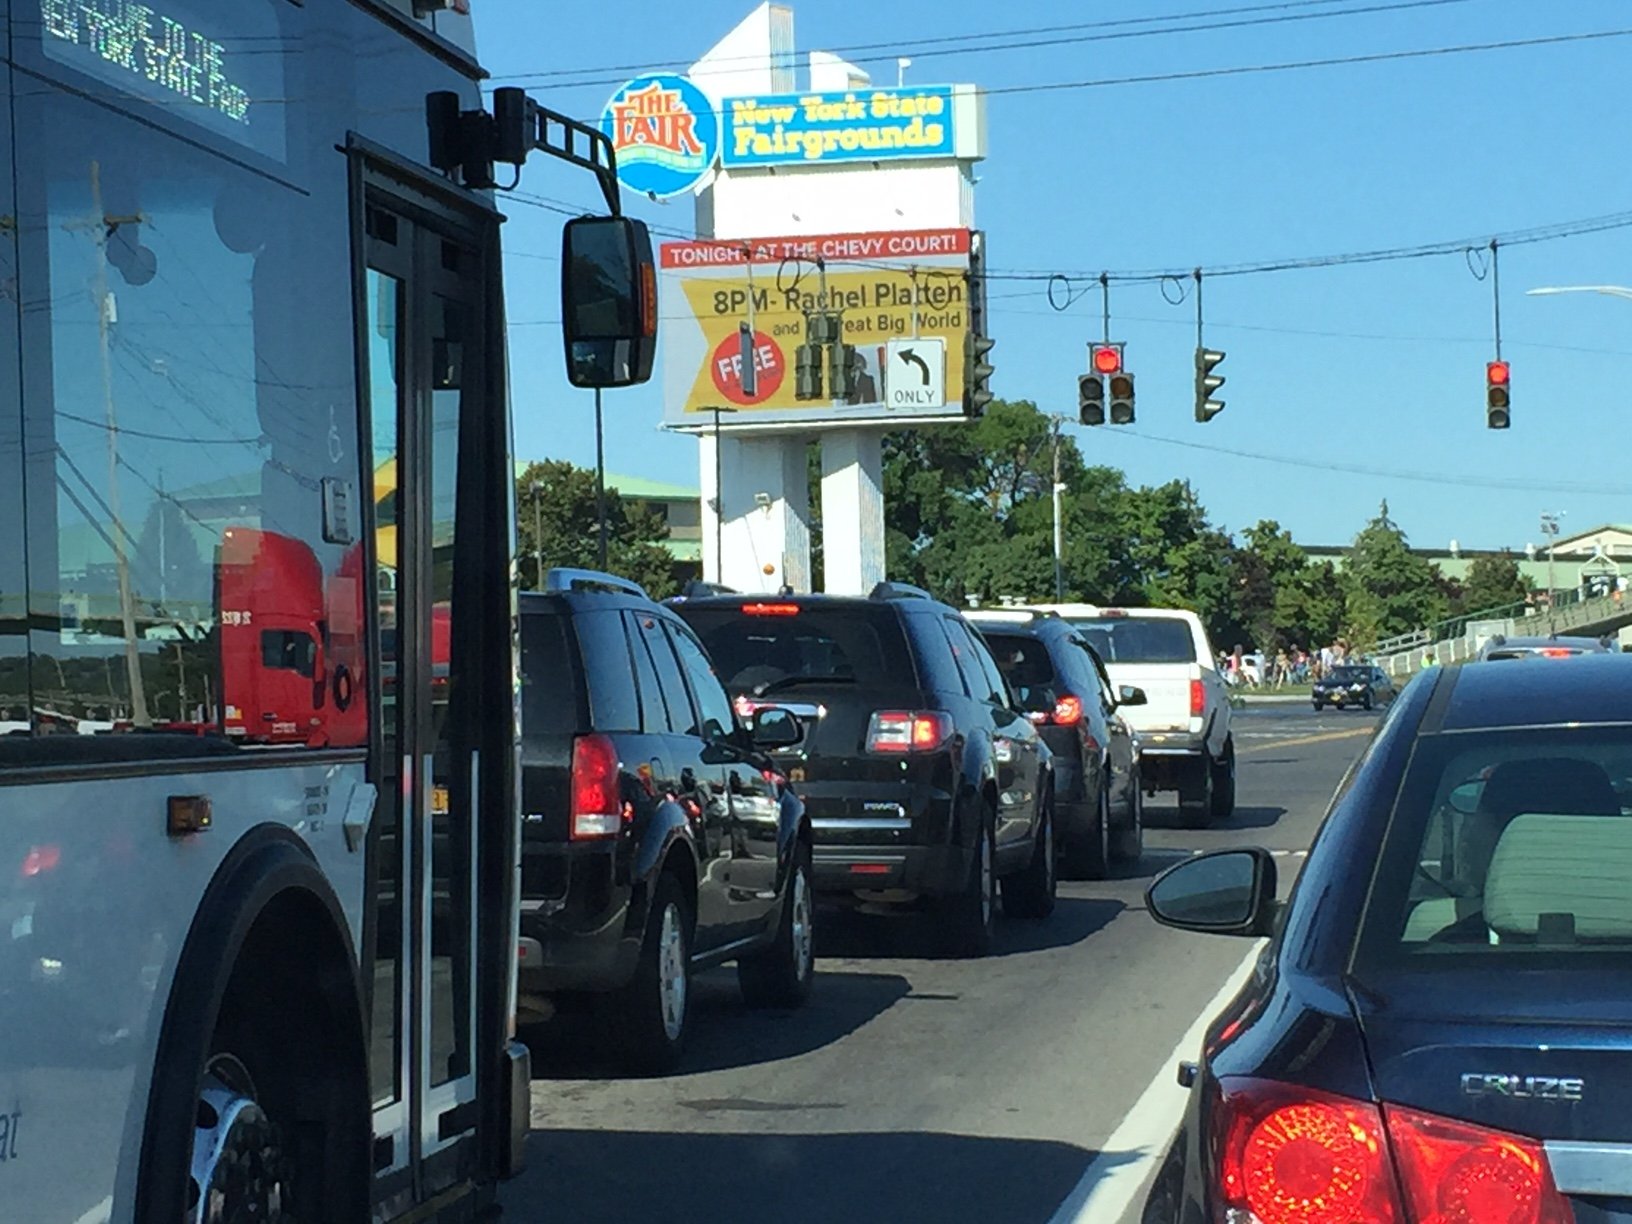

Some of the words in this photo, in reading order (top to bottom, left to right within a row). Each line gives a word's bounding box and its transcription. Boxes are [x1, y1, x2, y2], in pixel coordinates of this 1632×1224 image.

[161, 16, 185, 59] TO
[192, 32, 225, 80] THE
[145, 44, 204, 102] STATE
[209, 74, 250, 125] FAIR
[628, 86, 683, 114] THE
[732, 99, 796, 126] New
[801, 95, 867, 122] York
[870, 92, 944, 119] State
[613, 106, 702, 154] FAIR
[733, 116, 944, 159] Fairgrounds
[670, 245, 751, 265] TONIGH
[755, 243, 778, 260] AT
[782, 241, 818, 260] THE
[822, 236, 882, 258] CHEVY
[888, 233, 957, 253] COURT!
[785, 283, 866, 311] Rachel
[874, 281, 962, 306] Platten
[772, 320, 800, 337] and
[877, 313, 905, 335] Big
[894, 389, 936, 404] ONLY
[1460, 1073, 1585, 1100] CRUZE
